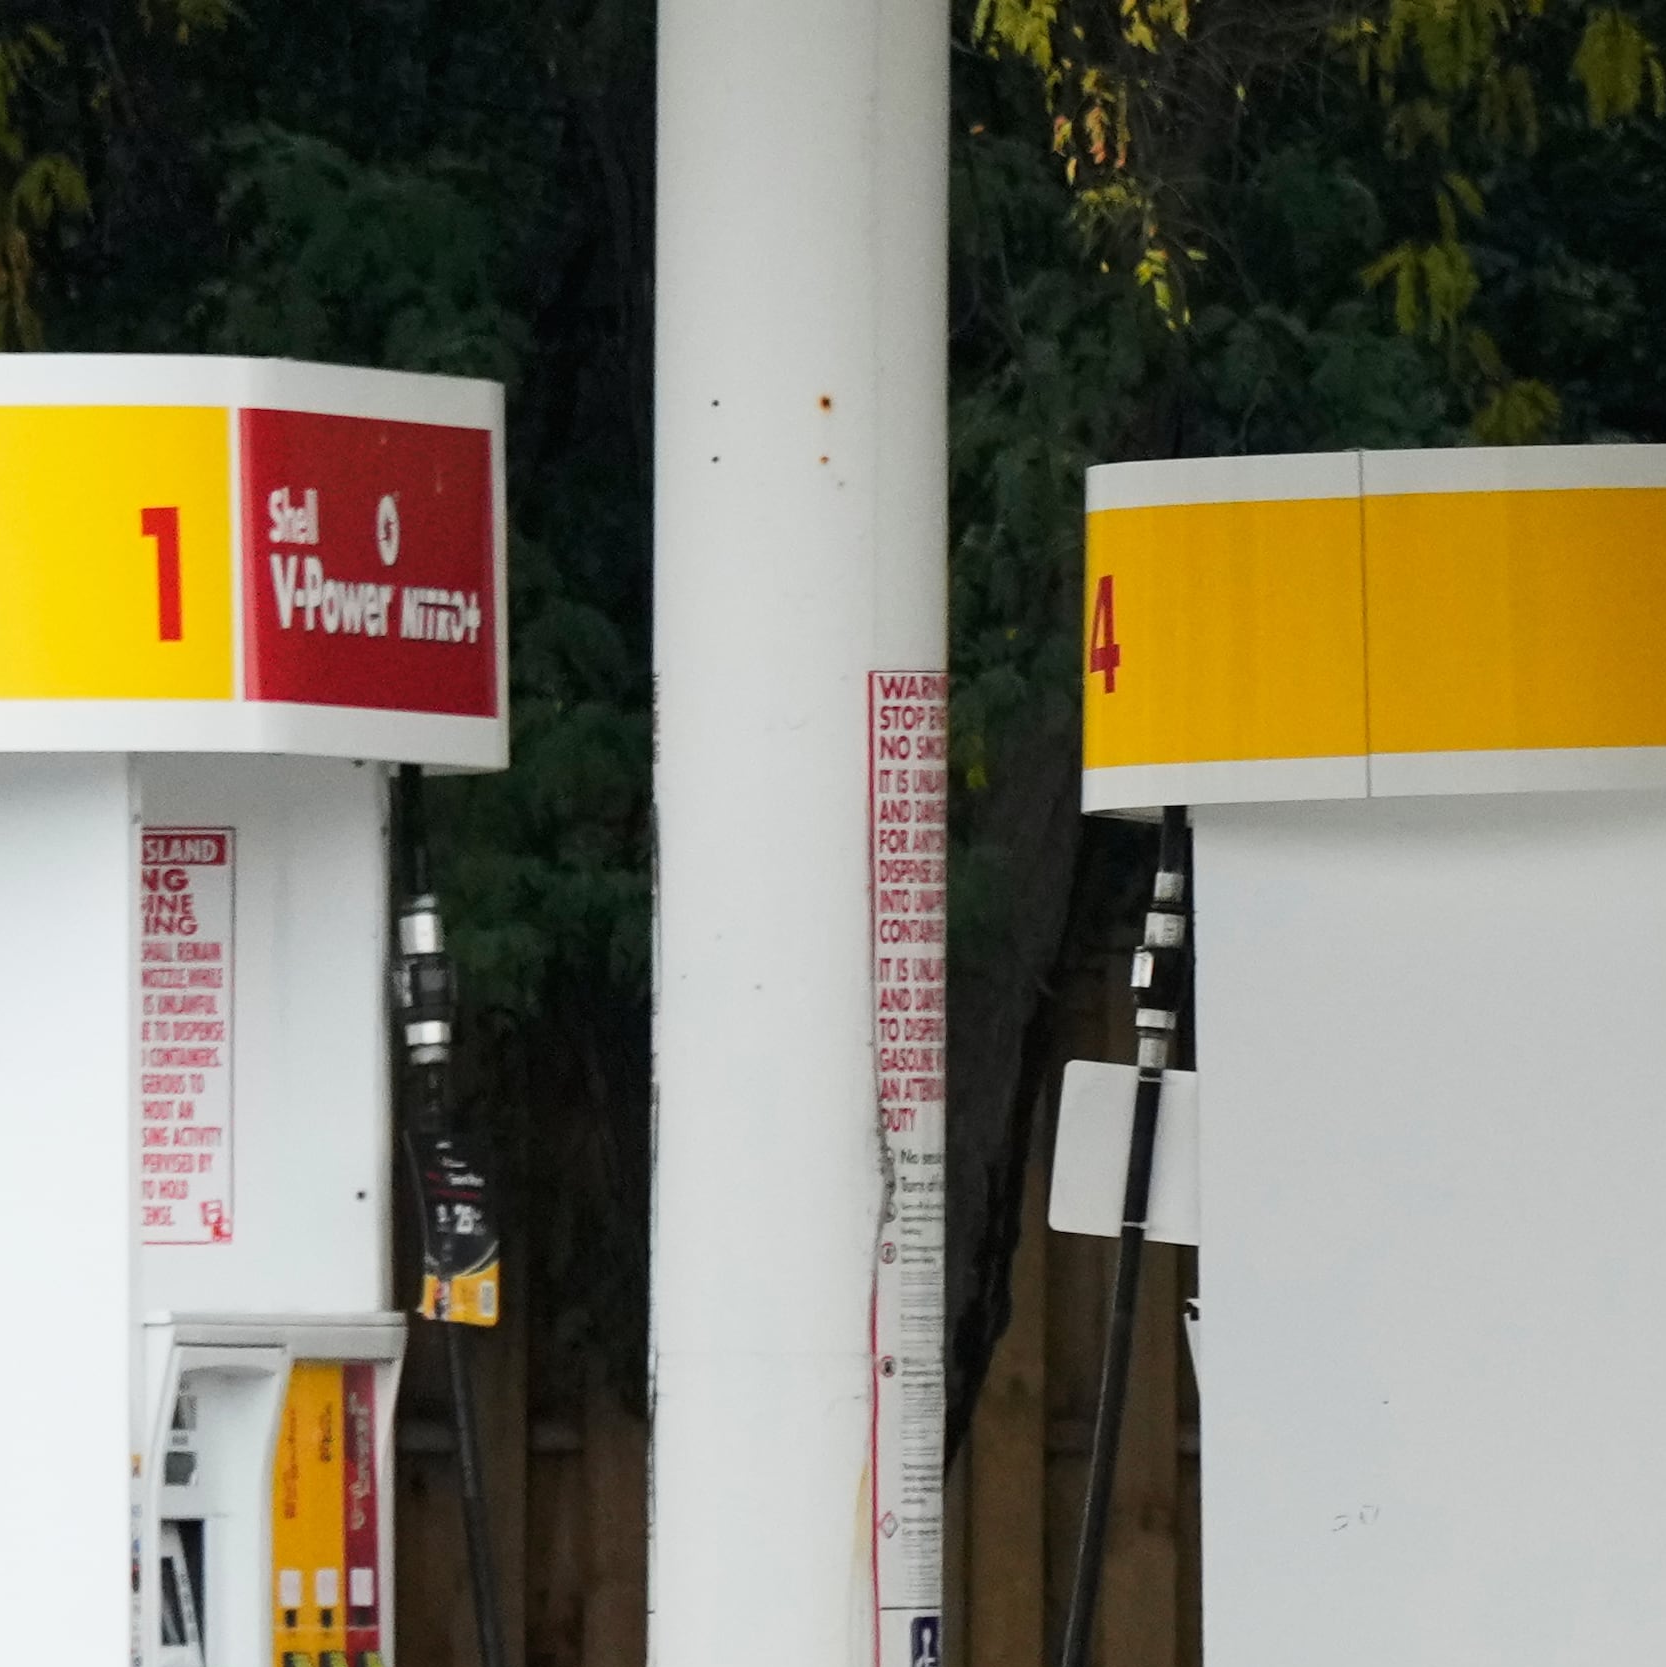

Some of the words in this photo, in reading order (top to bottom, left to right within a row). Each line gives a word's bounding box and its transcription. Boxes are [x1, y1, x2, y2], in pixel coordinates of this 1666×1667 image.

[268, 486, 319, 545] Shell
[141, 507, 182, 641] 1
[270, 553, 395, 637] V-Power
[1090, 574, 1120, 693] 4
[880, 705, 924, 730] STOP
[880, 735, 911, 760] NO
[879, 769, 893, 794] IT
[896, 769, 909, 794] IS
[879, 799, 912, 824] AND
[879, 829, 910, 854] FOR
[879, 958, 891, 982] IT
[896, 958, 909, 982] IS
[879, 988, 912, 1012] AND
[879, 1018, 900, 1042] TO
